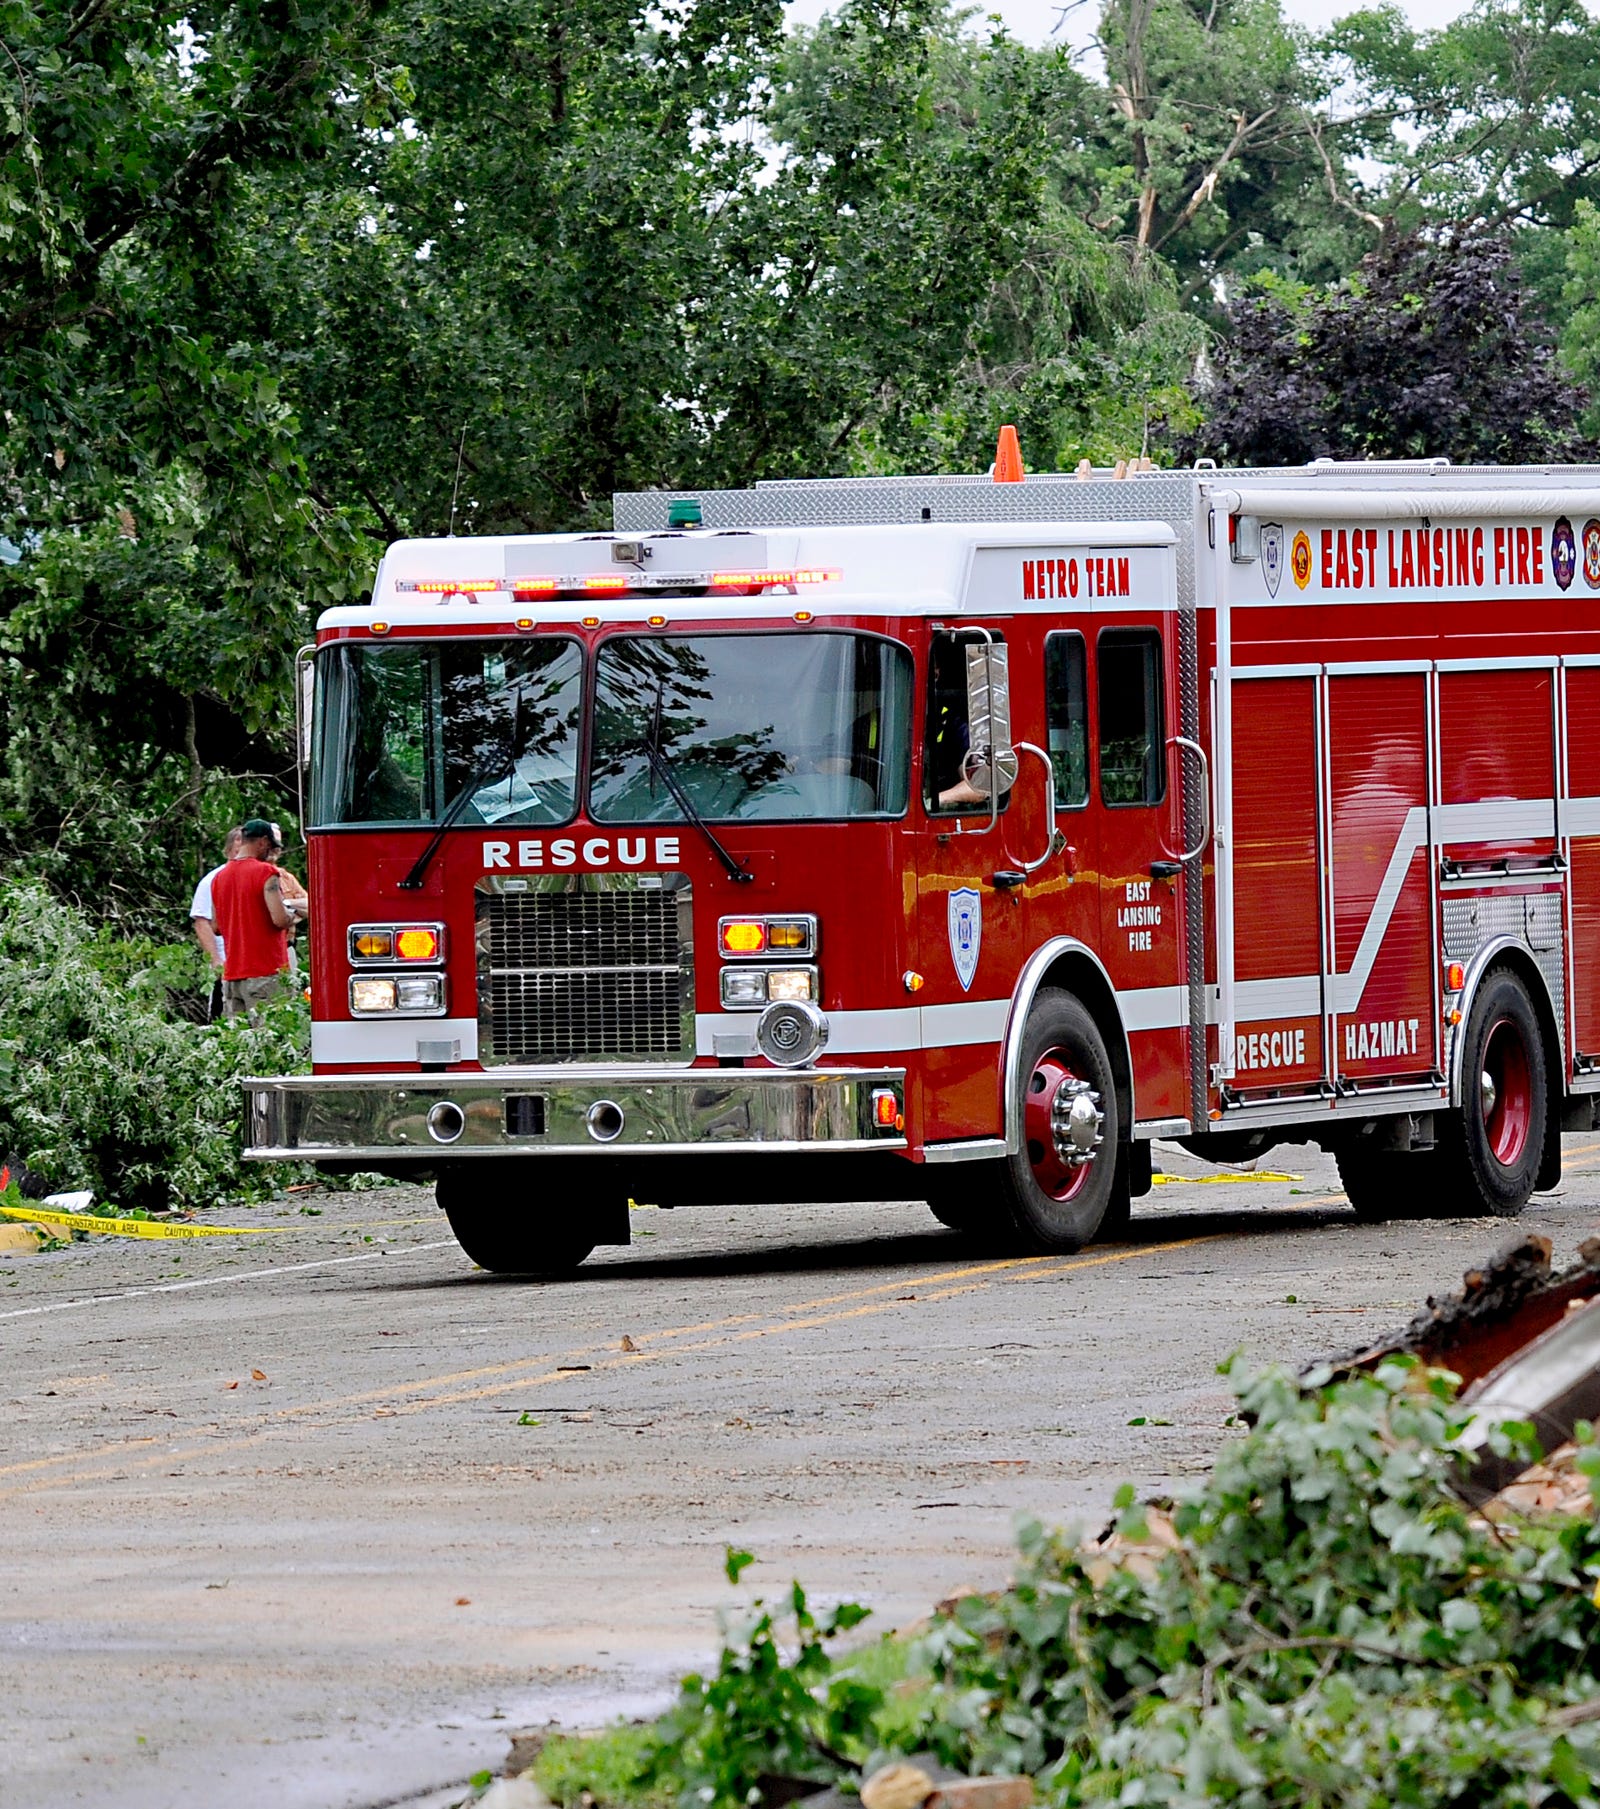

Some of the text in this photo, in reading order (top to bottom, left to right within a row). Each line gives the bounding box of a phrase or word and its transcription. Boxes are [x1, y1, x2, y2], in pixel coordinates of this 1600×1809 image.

[1321, 527, 1543, 589] EAST LANSING FIRE
[1022, 557, 1130, 600] METRO TEAM
[482, 838, 680, 868] RESCUE
[1126, 881, 1151, 902] EAST
[1117, 905, 1161, 928] LANSING
[1128, 930, 1152, 952] FIRE
[1236, 1029, 1305, 1071] RESCUE
[1345, 1019, 1419, 1061] HAZMAT
[65, 1216, 117, 1231] CONSTRUCTION
[121, 1222, 140, 1234] AREA
[164, 1226, 194, 1237] CAUTION
